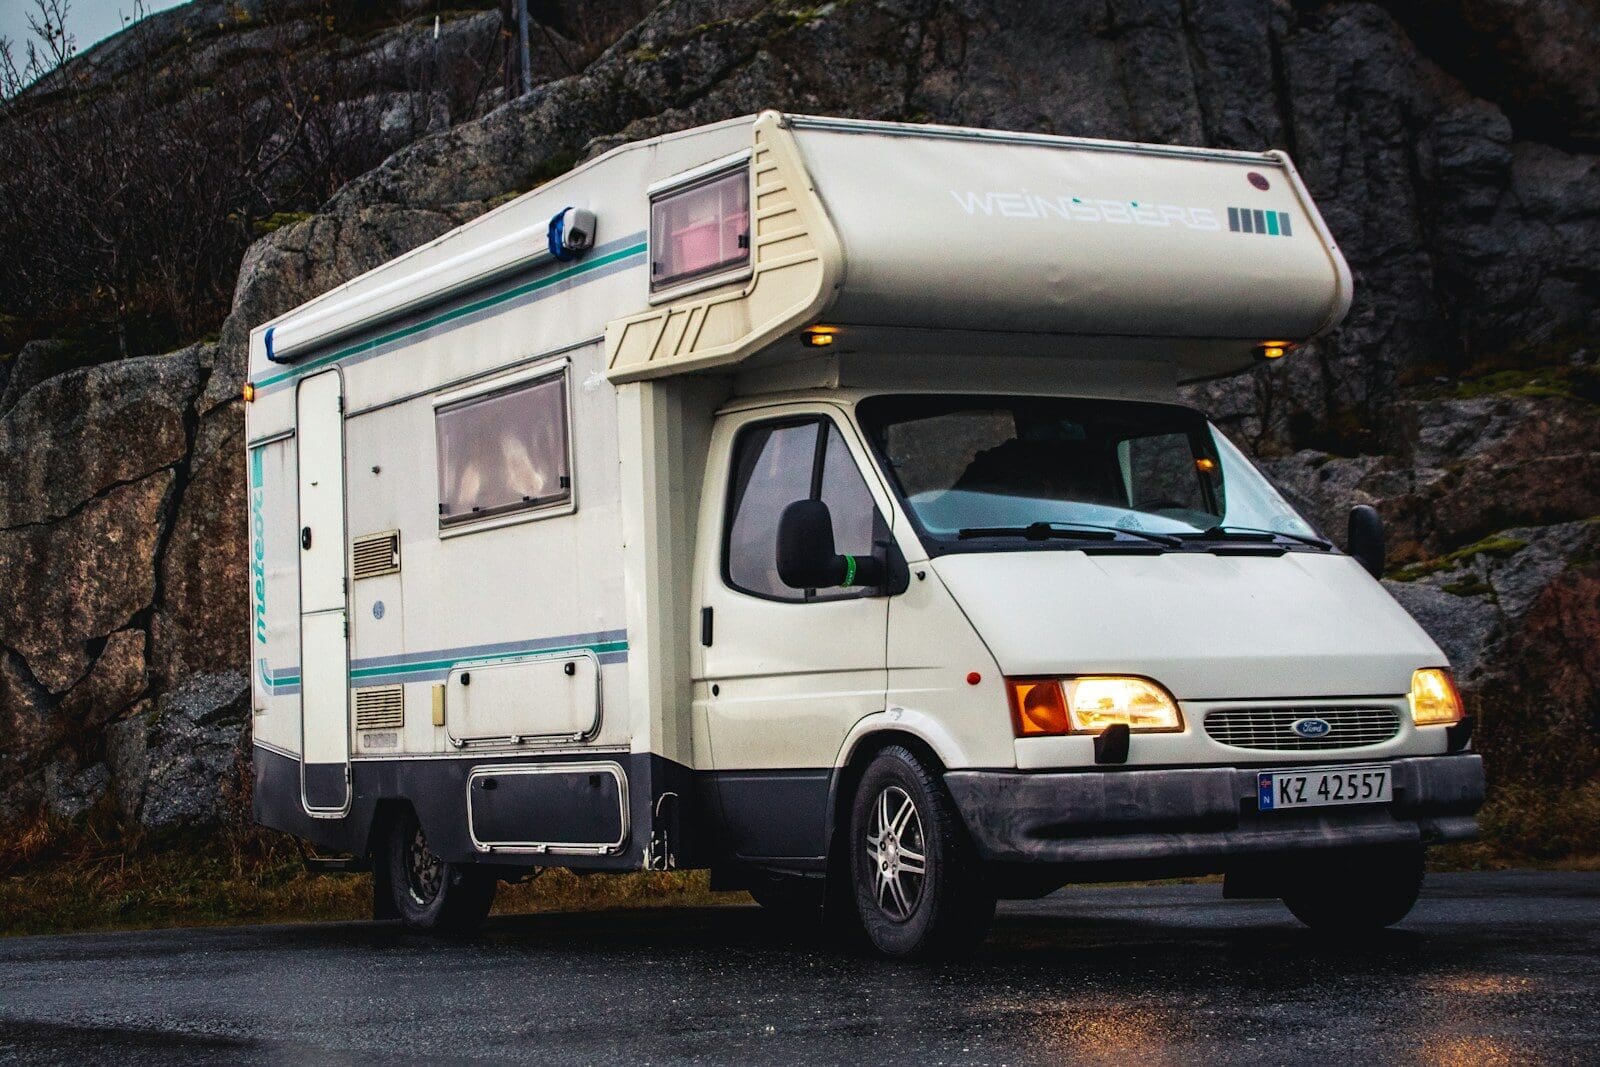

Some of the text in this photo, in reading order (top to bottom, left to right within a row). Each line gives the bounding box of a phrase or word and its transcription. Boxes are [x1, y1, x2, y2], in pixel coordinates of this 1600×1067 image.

[253, 491, 267, 644] meteor
[1302, 721, 1323, 733] Ford
[1279, 772, 1386, 804] KZ 42557
[1263, 795, 1271, 804] N
